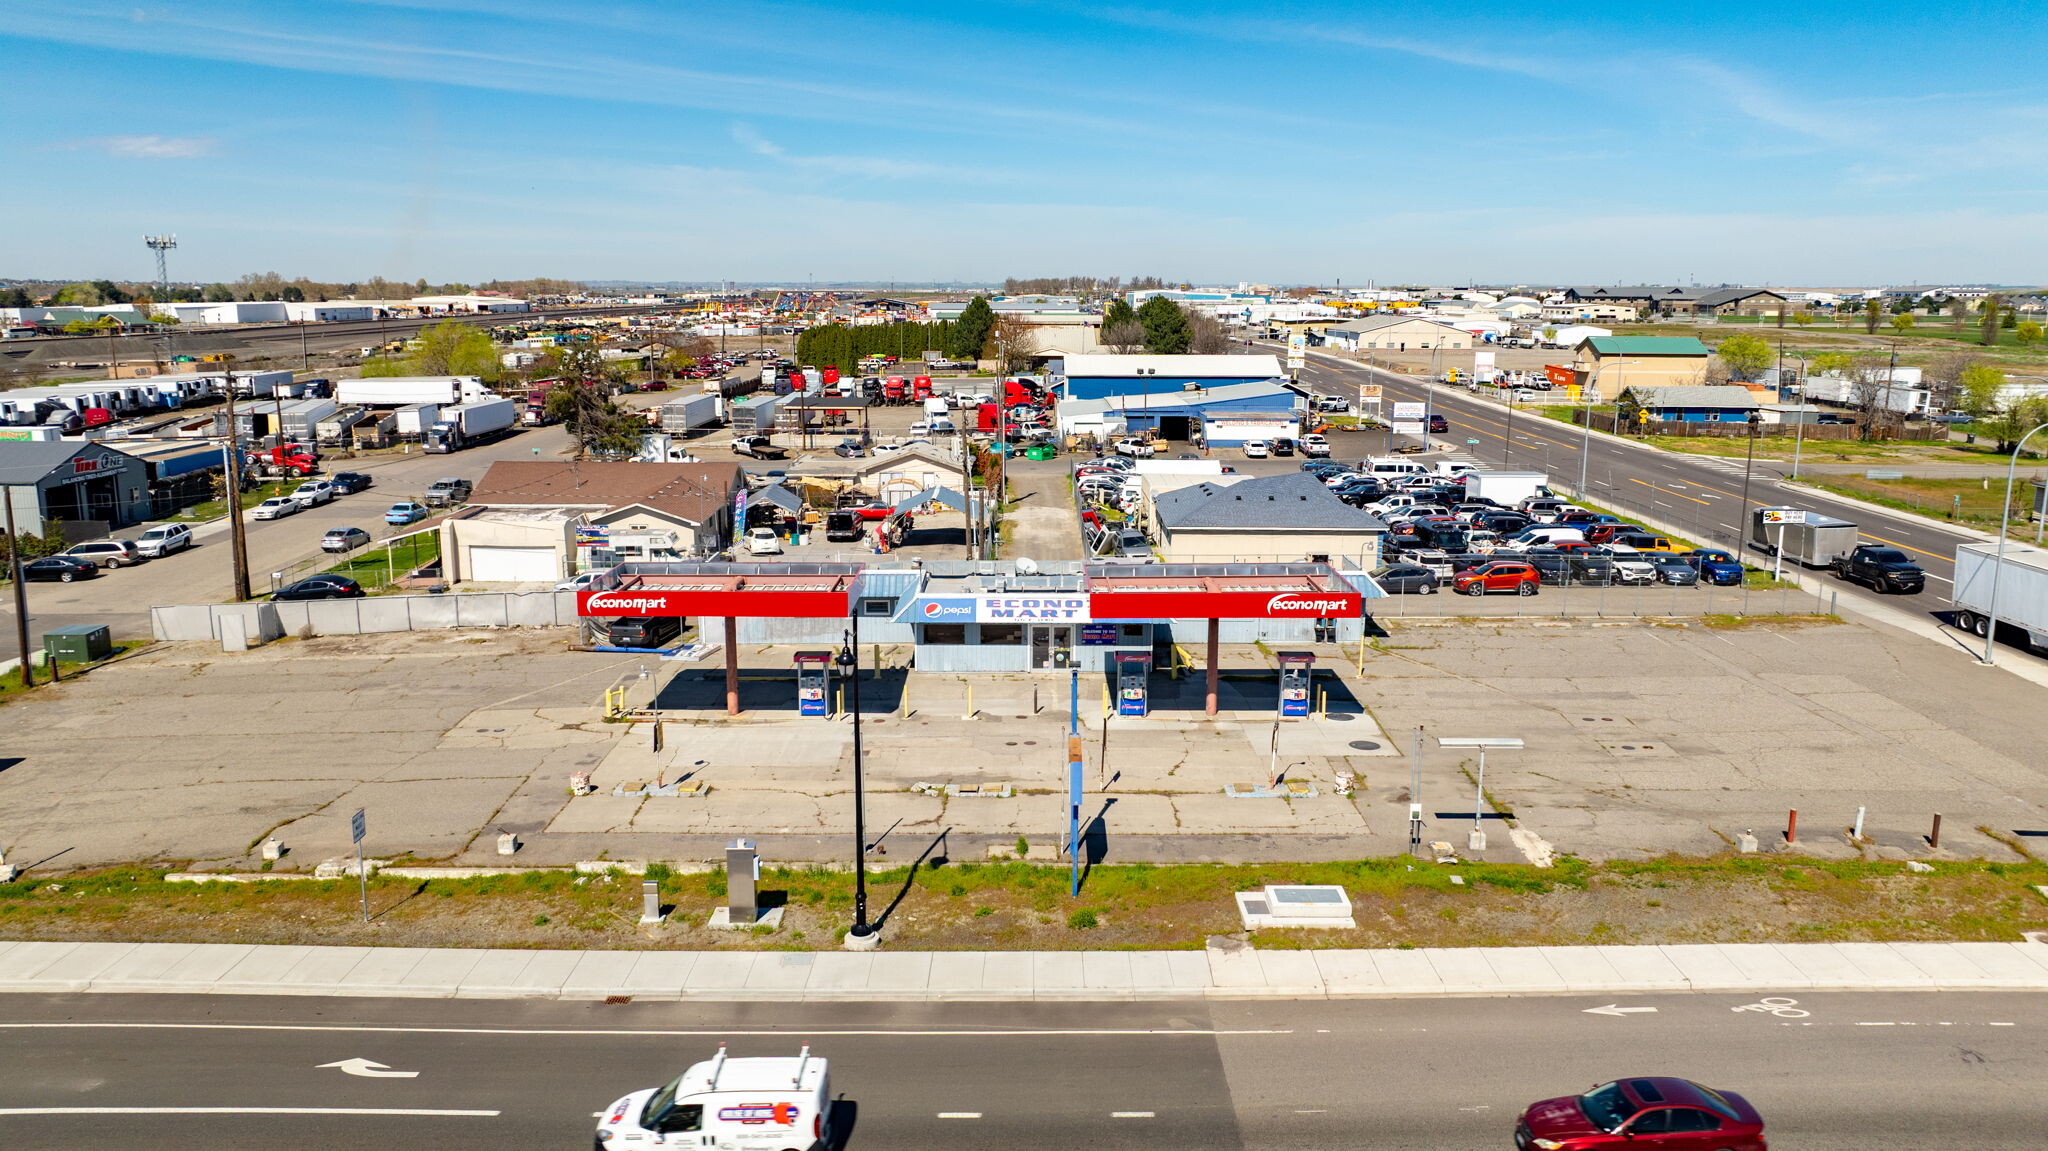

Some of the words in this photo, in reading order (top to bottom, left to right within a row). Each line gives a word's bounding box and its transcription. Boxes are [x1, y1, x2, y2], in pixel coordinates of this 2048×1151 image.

[986, 599, 1084, 608] ECONO
[943, 606, 972, 617] pepsi
[991, 609, 1078, 618] MART
